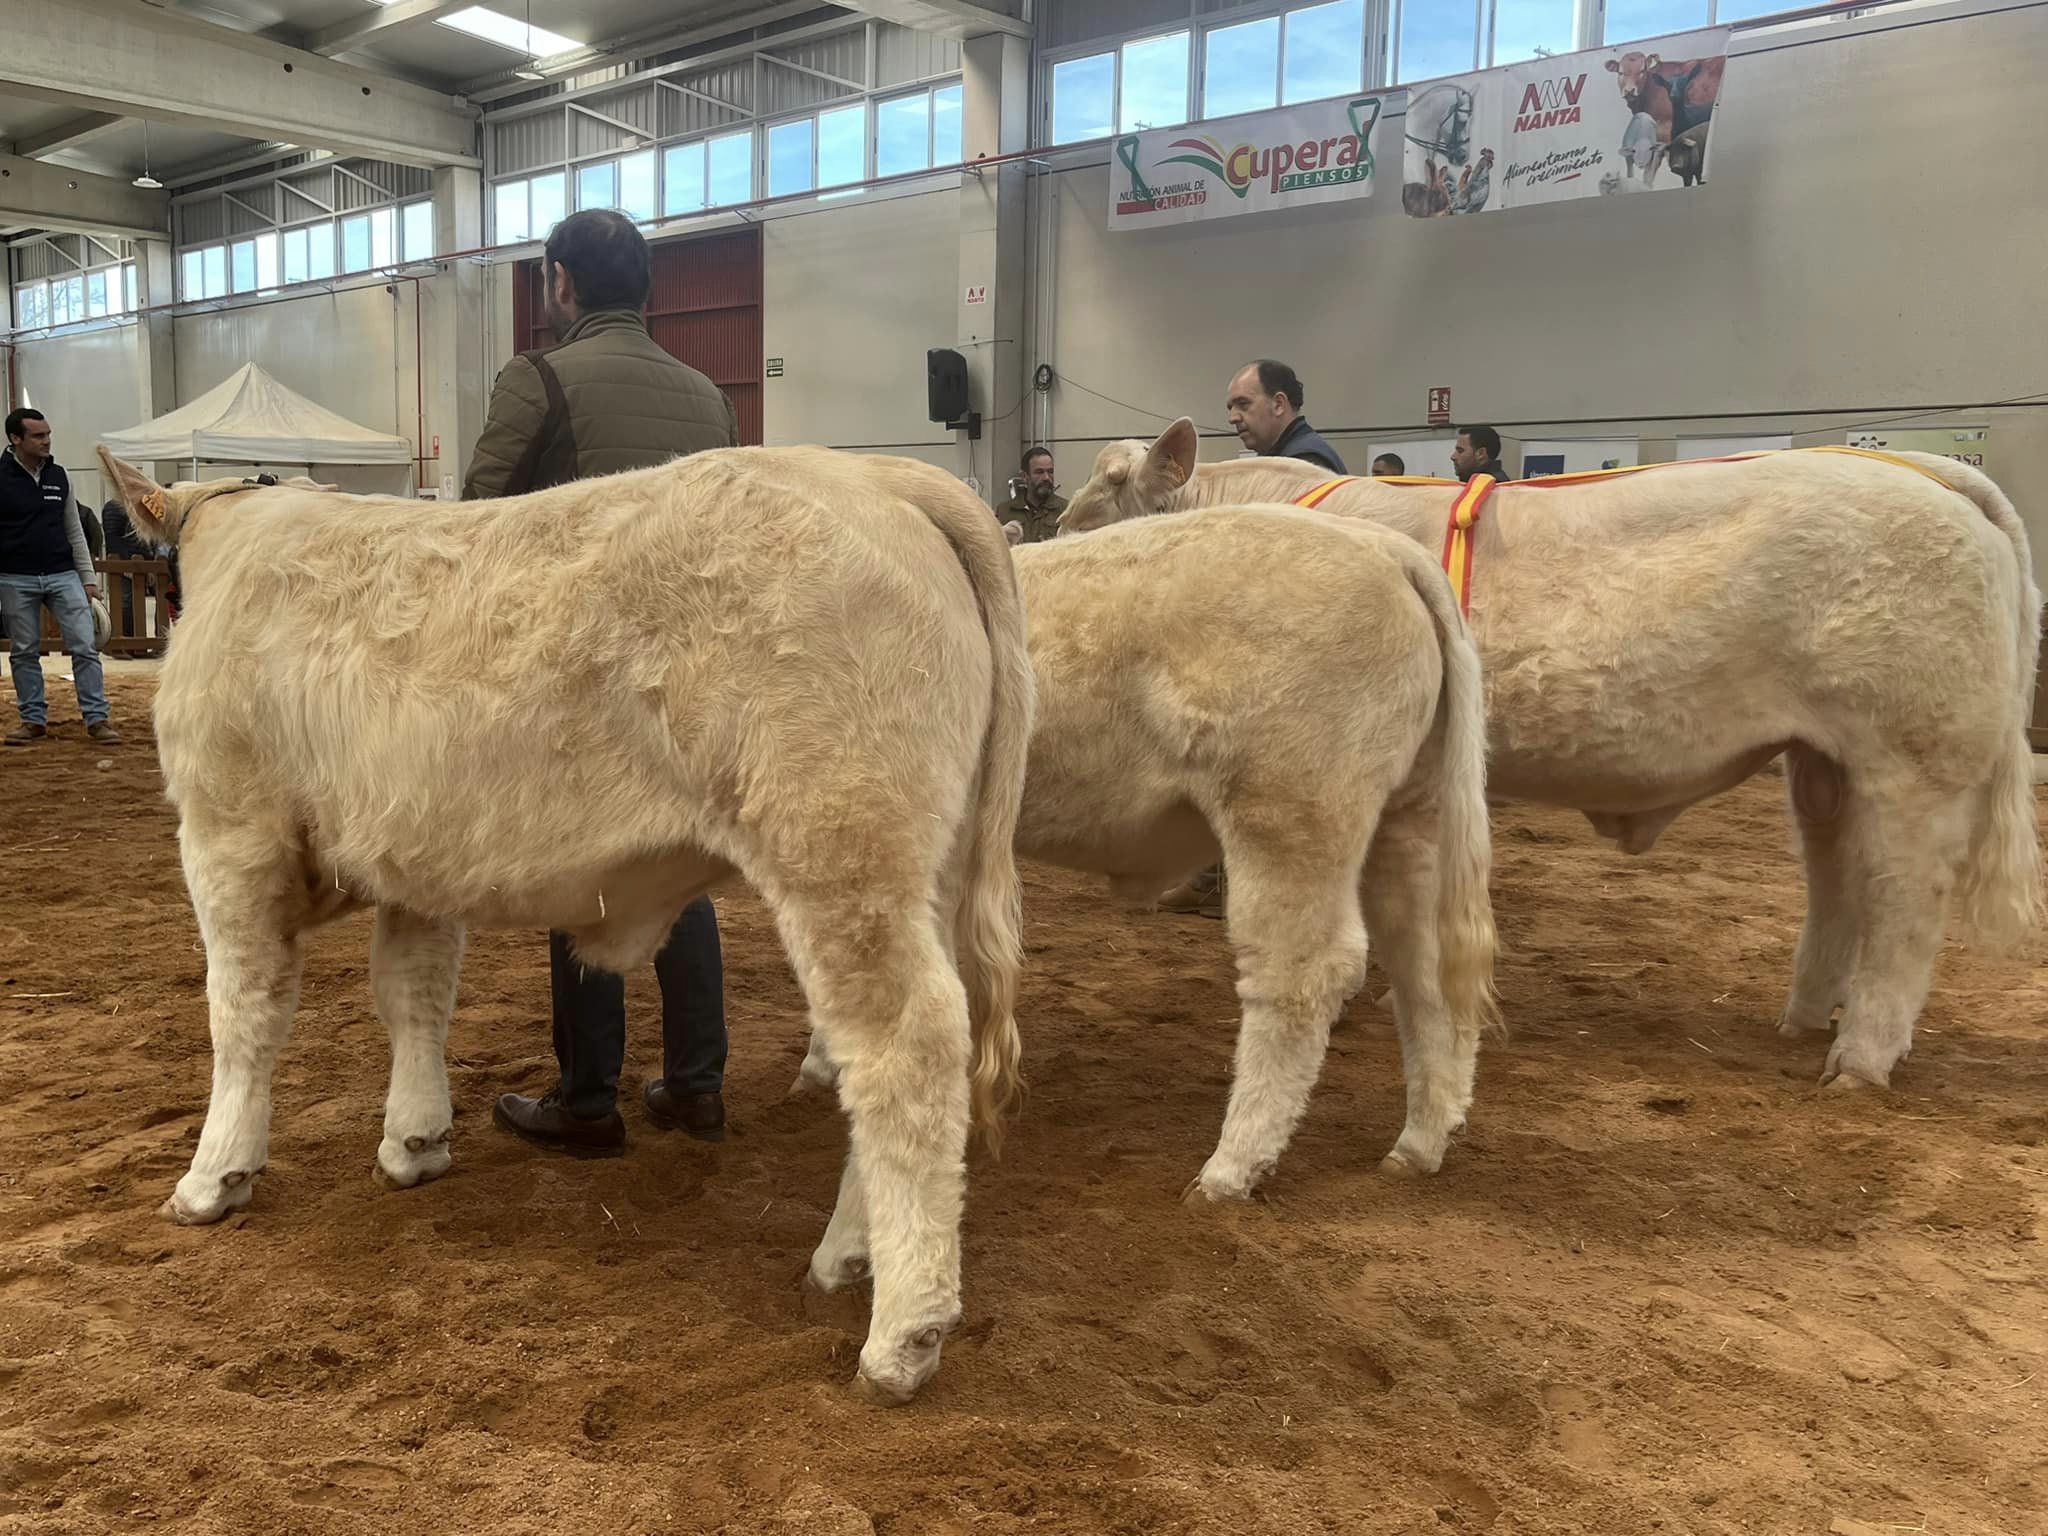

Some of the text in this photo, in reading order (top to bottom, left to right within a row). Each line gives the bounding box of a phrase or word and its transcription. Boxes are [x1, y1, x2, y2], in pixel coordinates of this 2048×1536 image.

[1513, 106, 1581, 133] NANTA
[1282, 168, 1363, 187] PIENSOS
[1502, 146, 1587, 188] Alimentamos
[1526, 149, 1604, 187] crecimiento
[1162, 181, 1192, 195] ANIMAL
[1194, 180, 1205, 191] DE
[1154, 192, 1204, 210] CALIDAD
